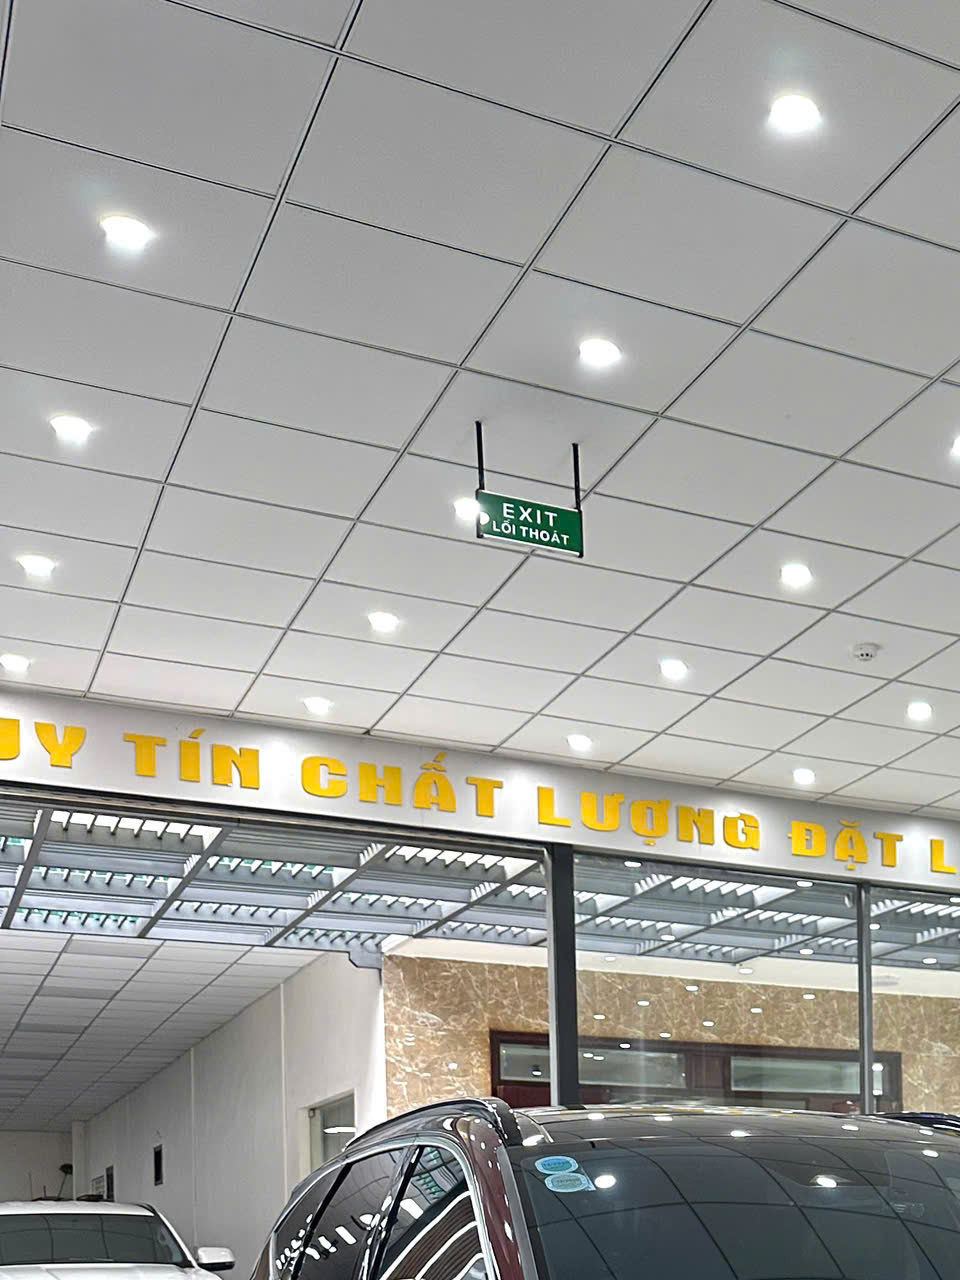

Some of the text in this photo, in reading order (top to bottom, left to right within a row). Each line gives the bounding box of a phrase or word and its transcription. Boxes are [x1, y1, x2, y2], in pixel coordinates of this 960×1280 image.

[503, 503, 557, 526] EXIT
[520, 527, 569, 545] THOÁT
[124, 728, 260, 790] TÍN
[302, 752, 503, 818] CHẤT
[538, 786, 761, 851] LƯỢNG
[788, 820, 904, 871] ĐẶT
